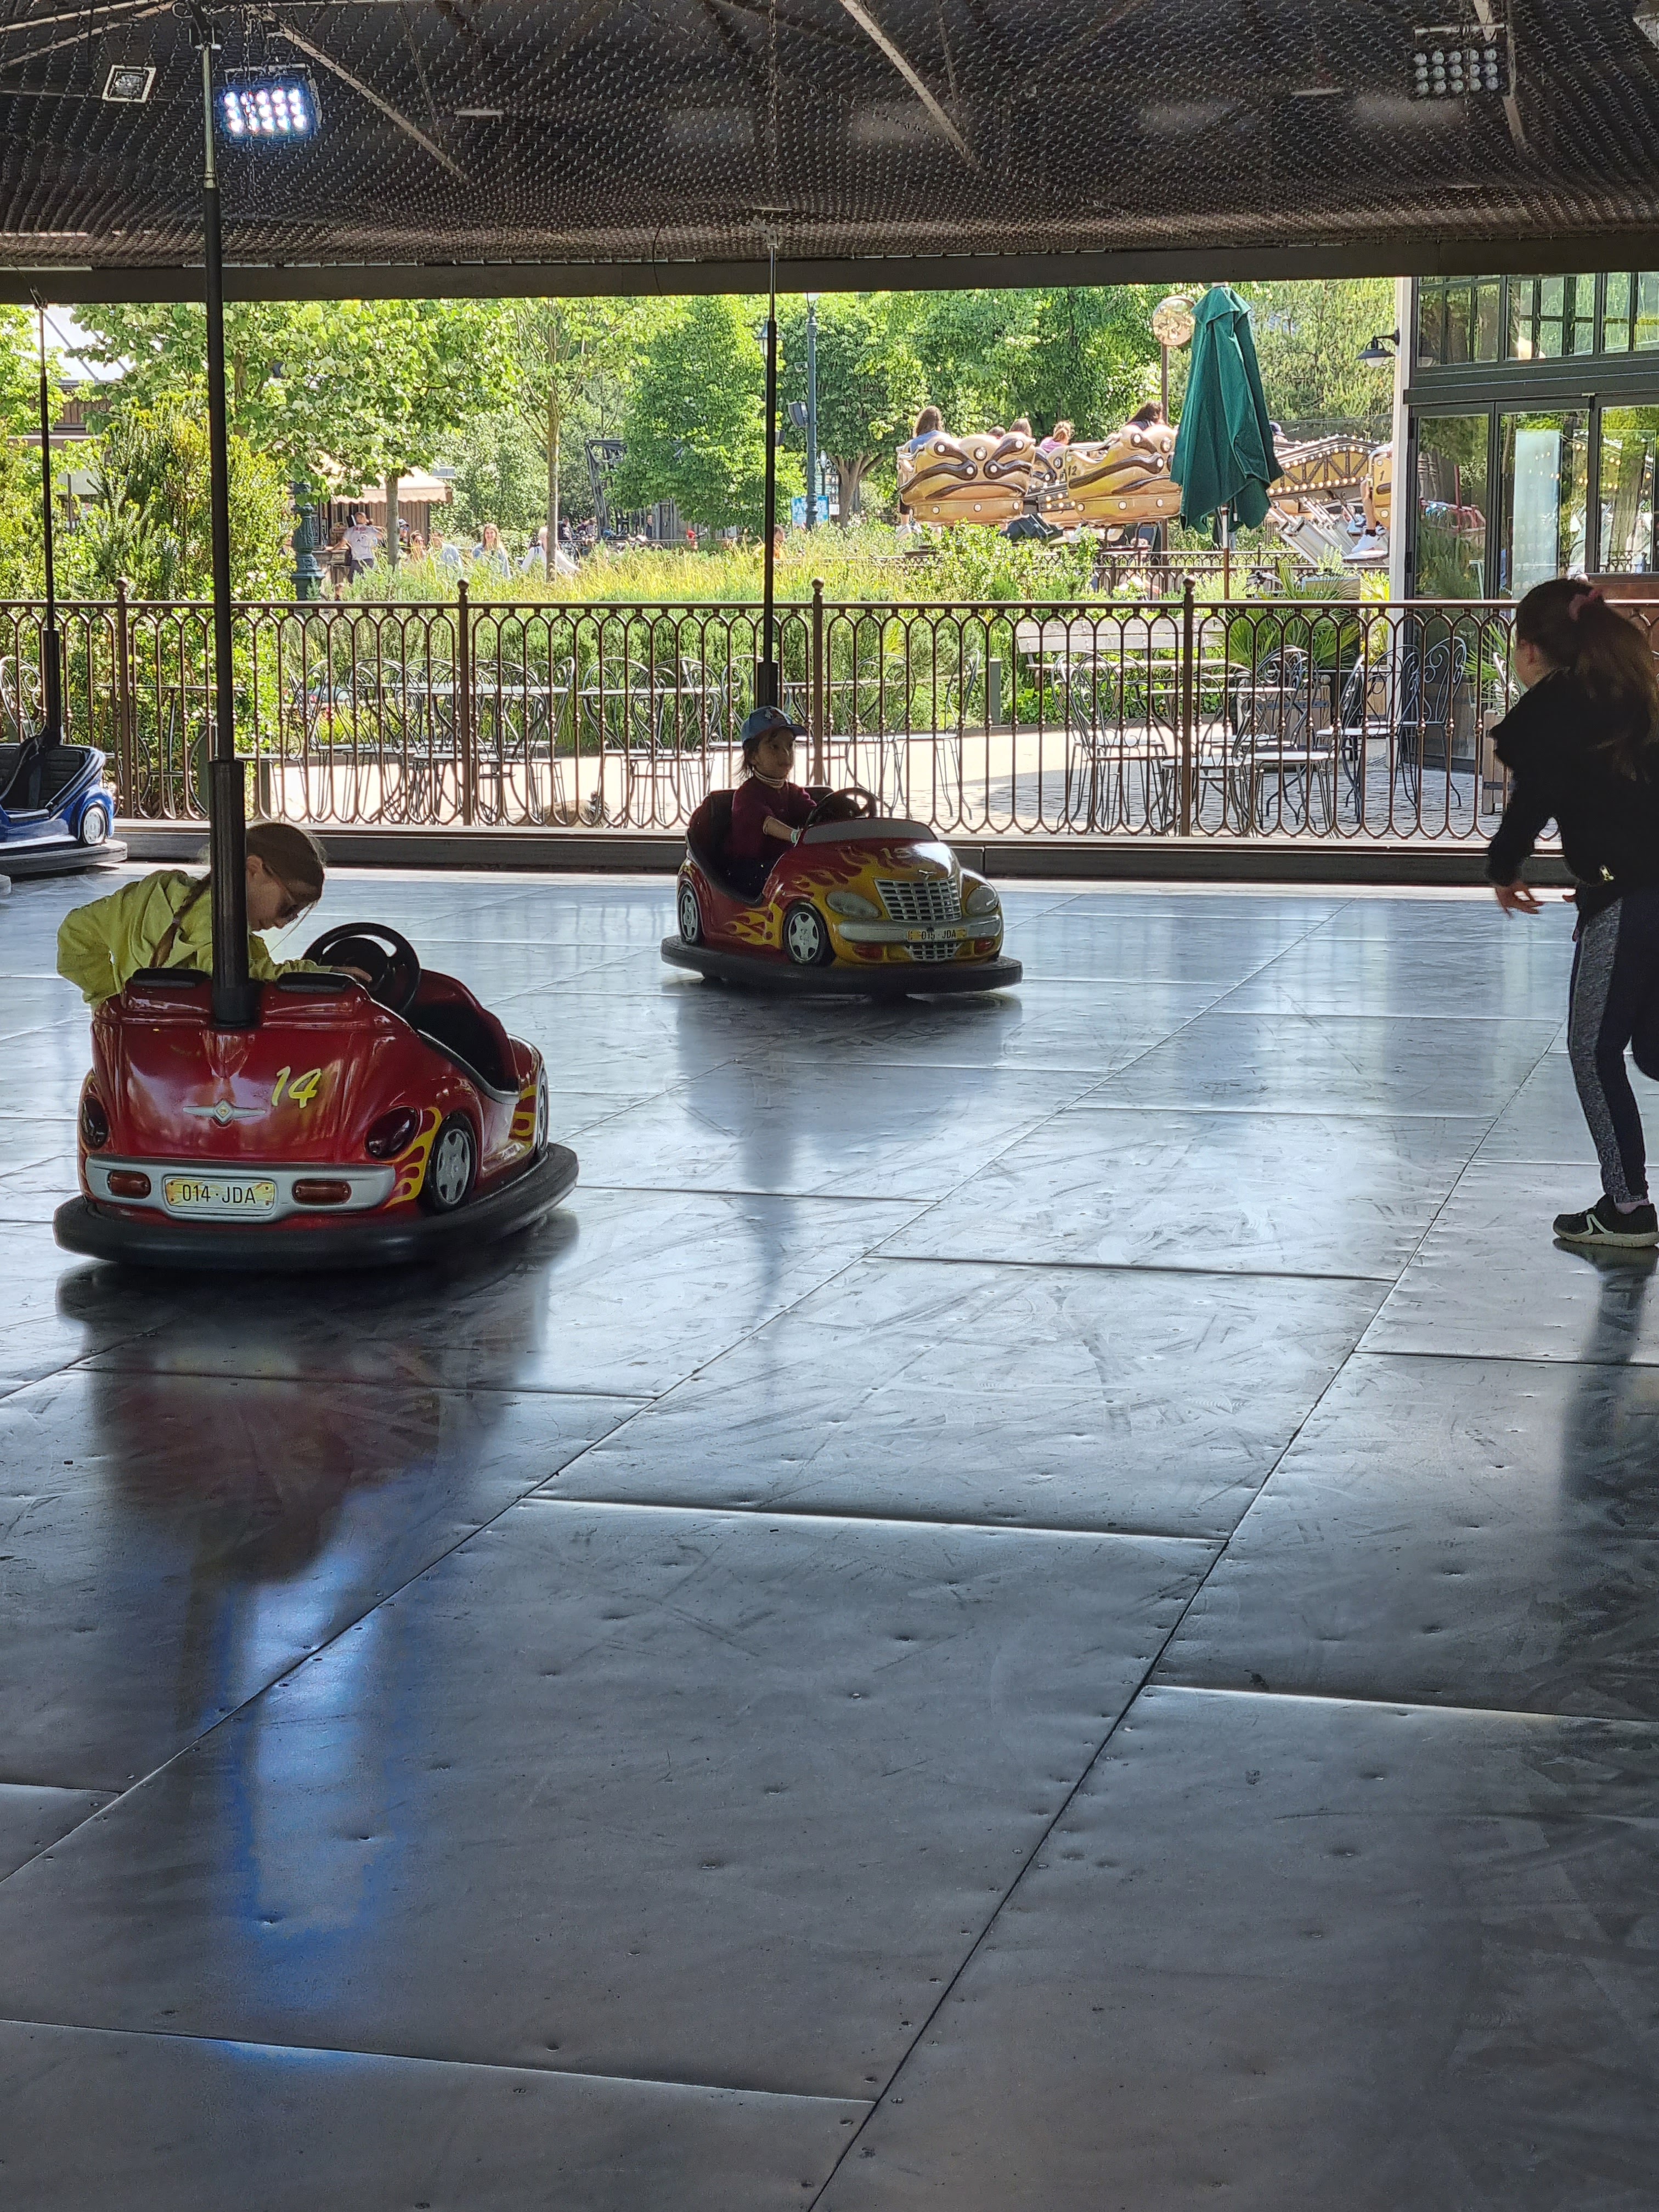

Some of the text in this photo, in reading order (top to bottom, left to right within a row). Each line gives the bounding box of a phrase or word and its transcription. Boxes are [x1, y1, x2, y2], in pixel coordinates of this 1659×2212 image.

[1068, 465, 1077, 476] 12
[880, 848, 913, 859] 15
[942, 929, 956, 939] JDA
[271, 1065, 321, 1109] 14
[183, 1184, 256, 1204] 014 JDA
